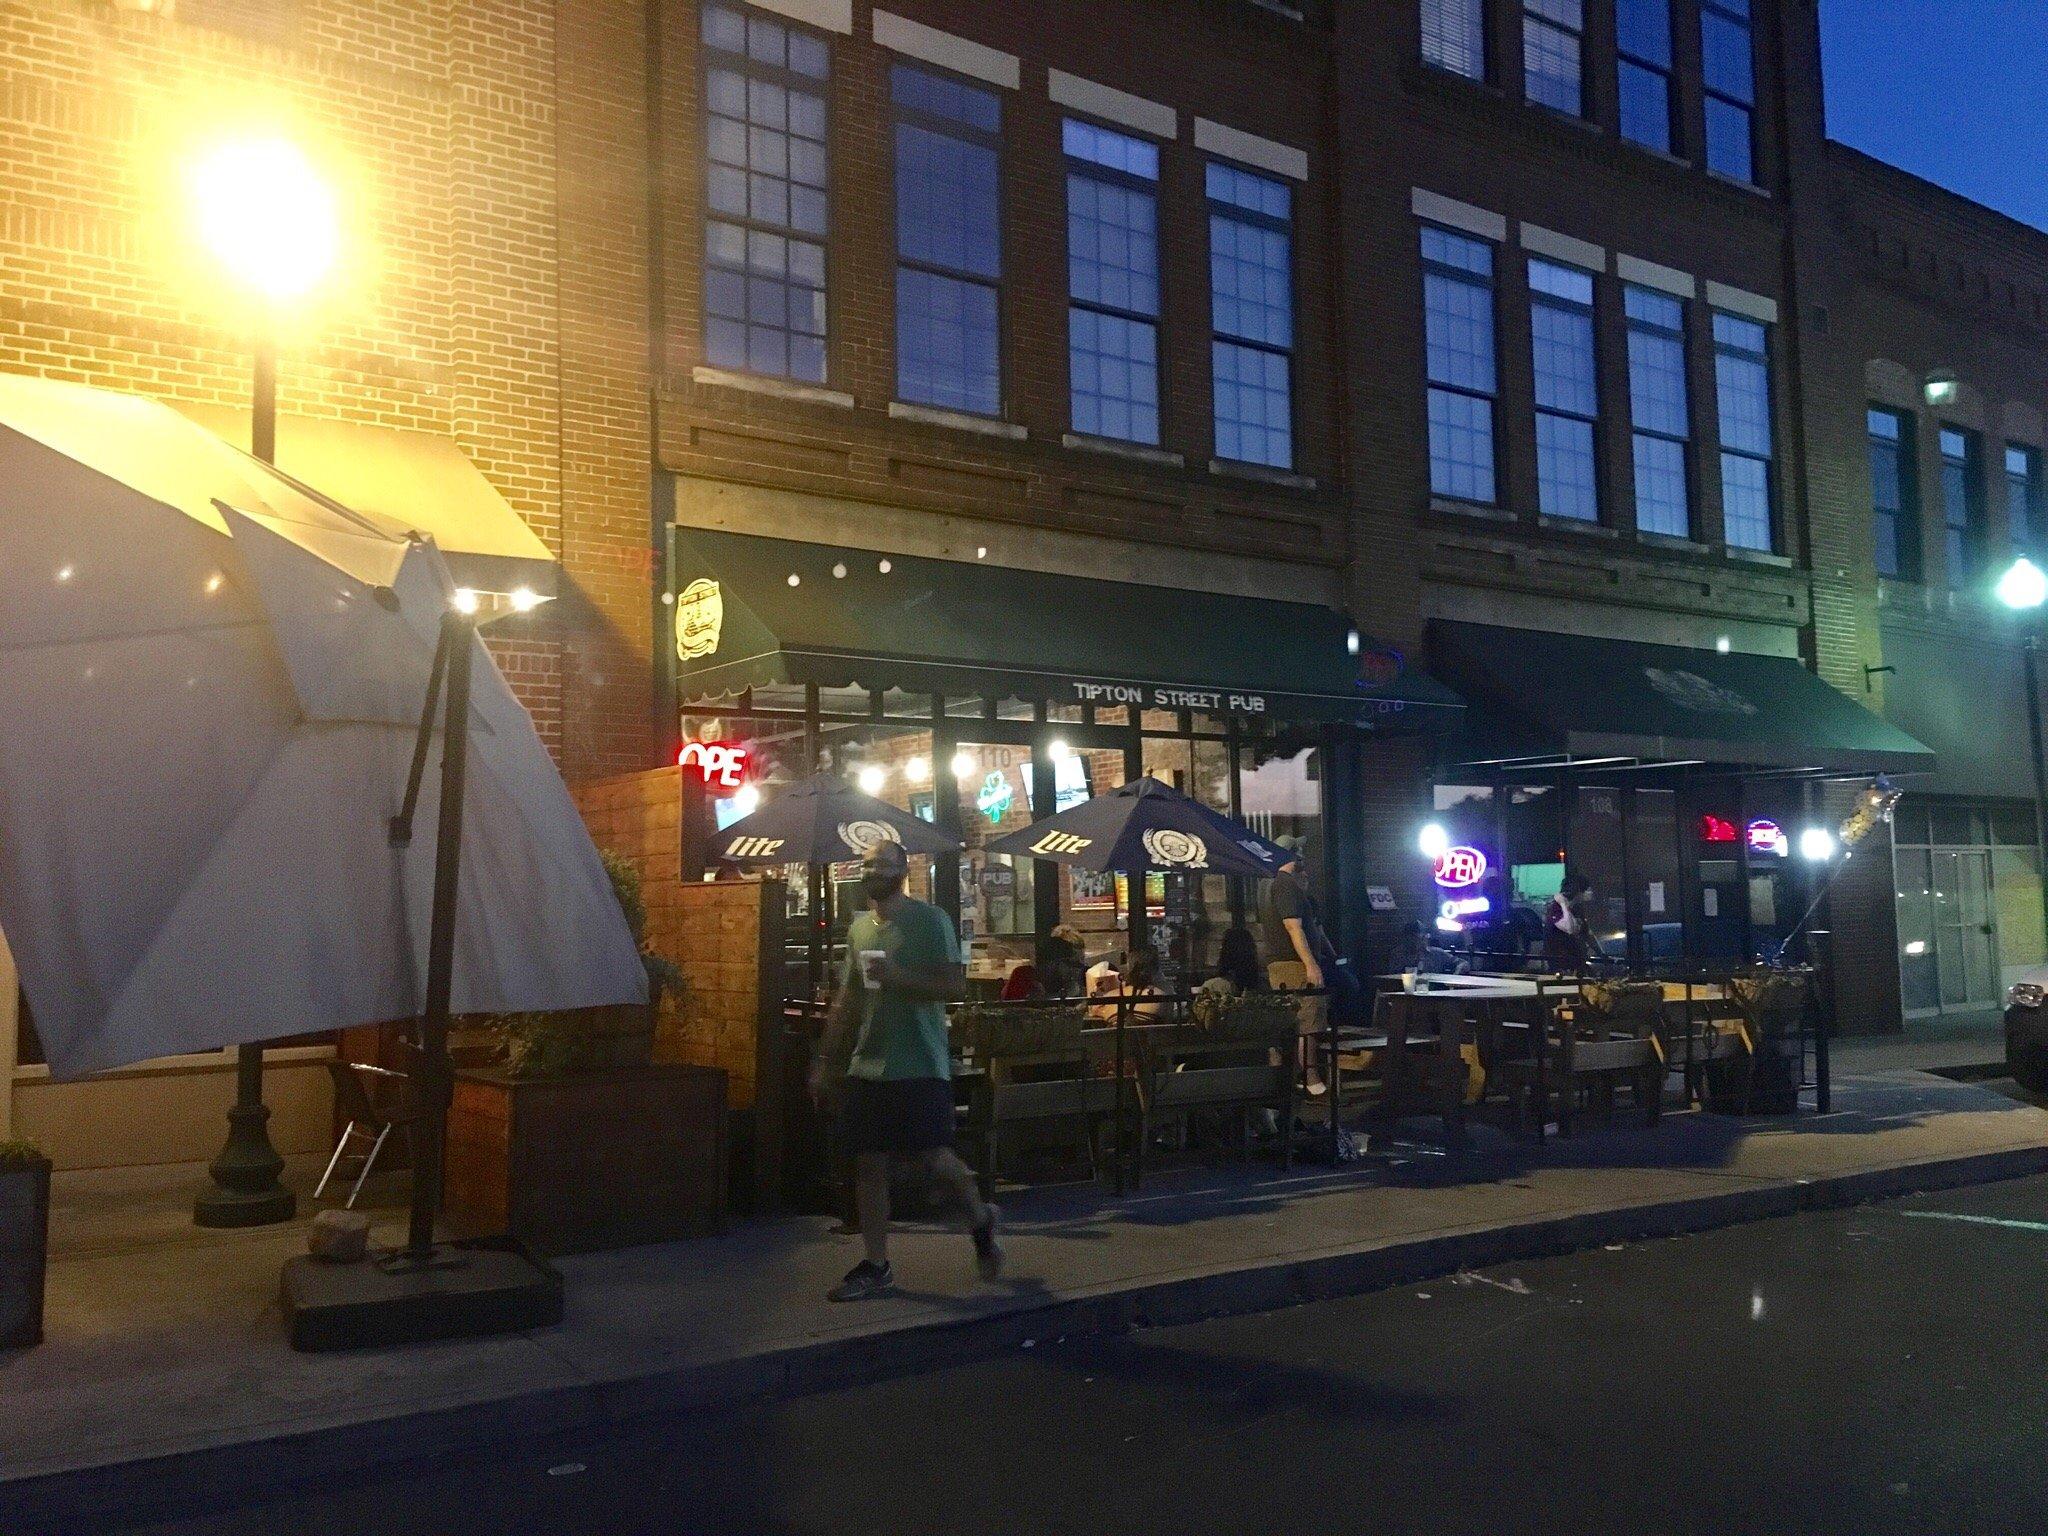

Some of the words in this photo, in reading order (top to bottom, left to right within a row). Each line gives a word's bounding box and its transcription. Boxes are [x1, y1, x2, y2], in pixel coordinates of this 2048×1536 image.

[1072, 682, 1143, 704] TIPTON
[1154, 688, 1222, 710] STREET
[1229, 694, 1266, 712] PUB
[977, 747, 1013, 768] 110
[726, 836, 784, 857] Lite
[1029, 829, 1092, 855] Lite
[983, 871, 1013, 885] PUB
[1436, 852, 1482, 884] OPEN
[1370, 891, 1393, 905] FDC
